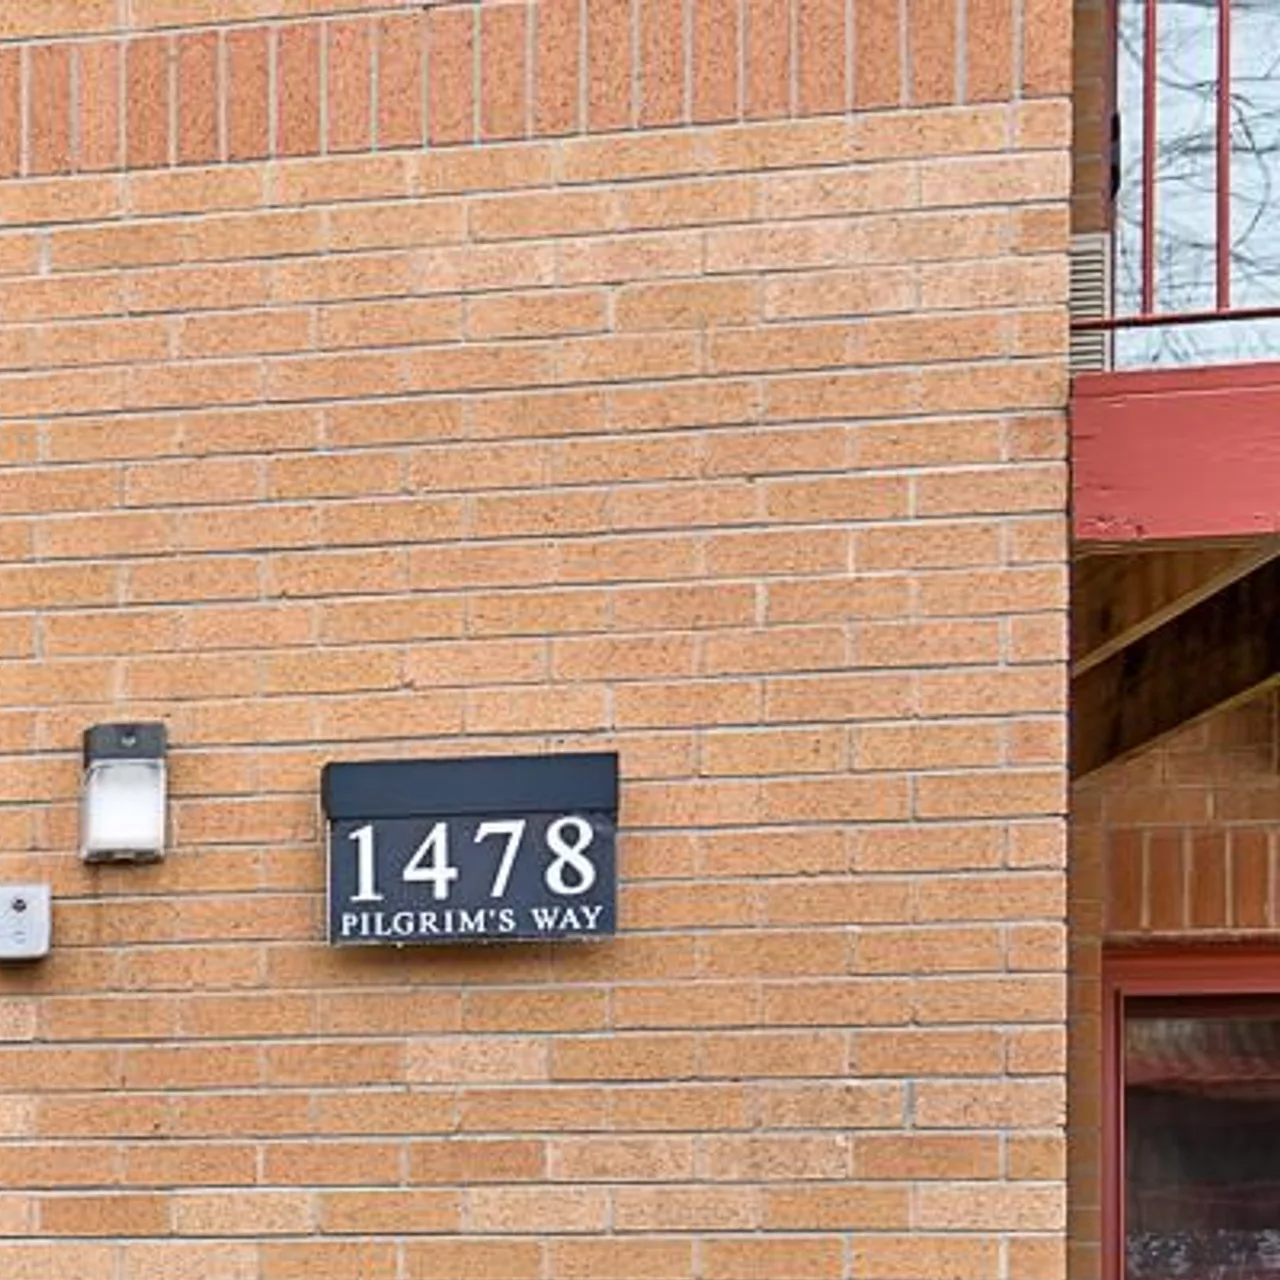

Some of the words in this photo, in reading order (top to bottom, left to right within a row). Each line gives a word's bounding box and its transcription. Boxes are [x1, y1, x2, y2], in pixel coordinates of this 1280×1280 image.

[348, 815, 596, 902] 1478
[340, 908, 518, 937] PILGRIM'S
[532, 905, 604, 931] WAY
